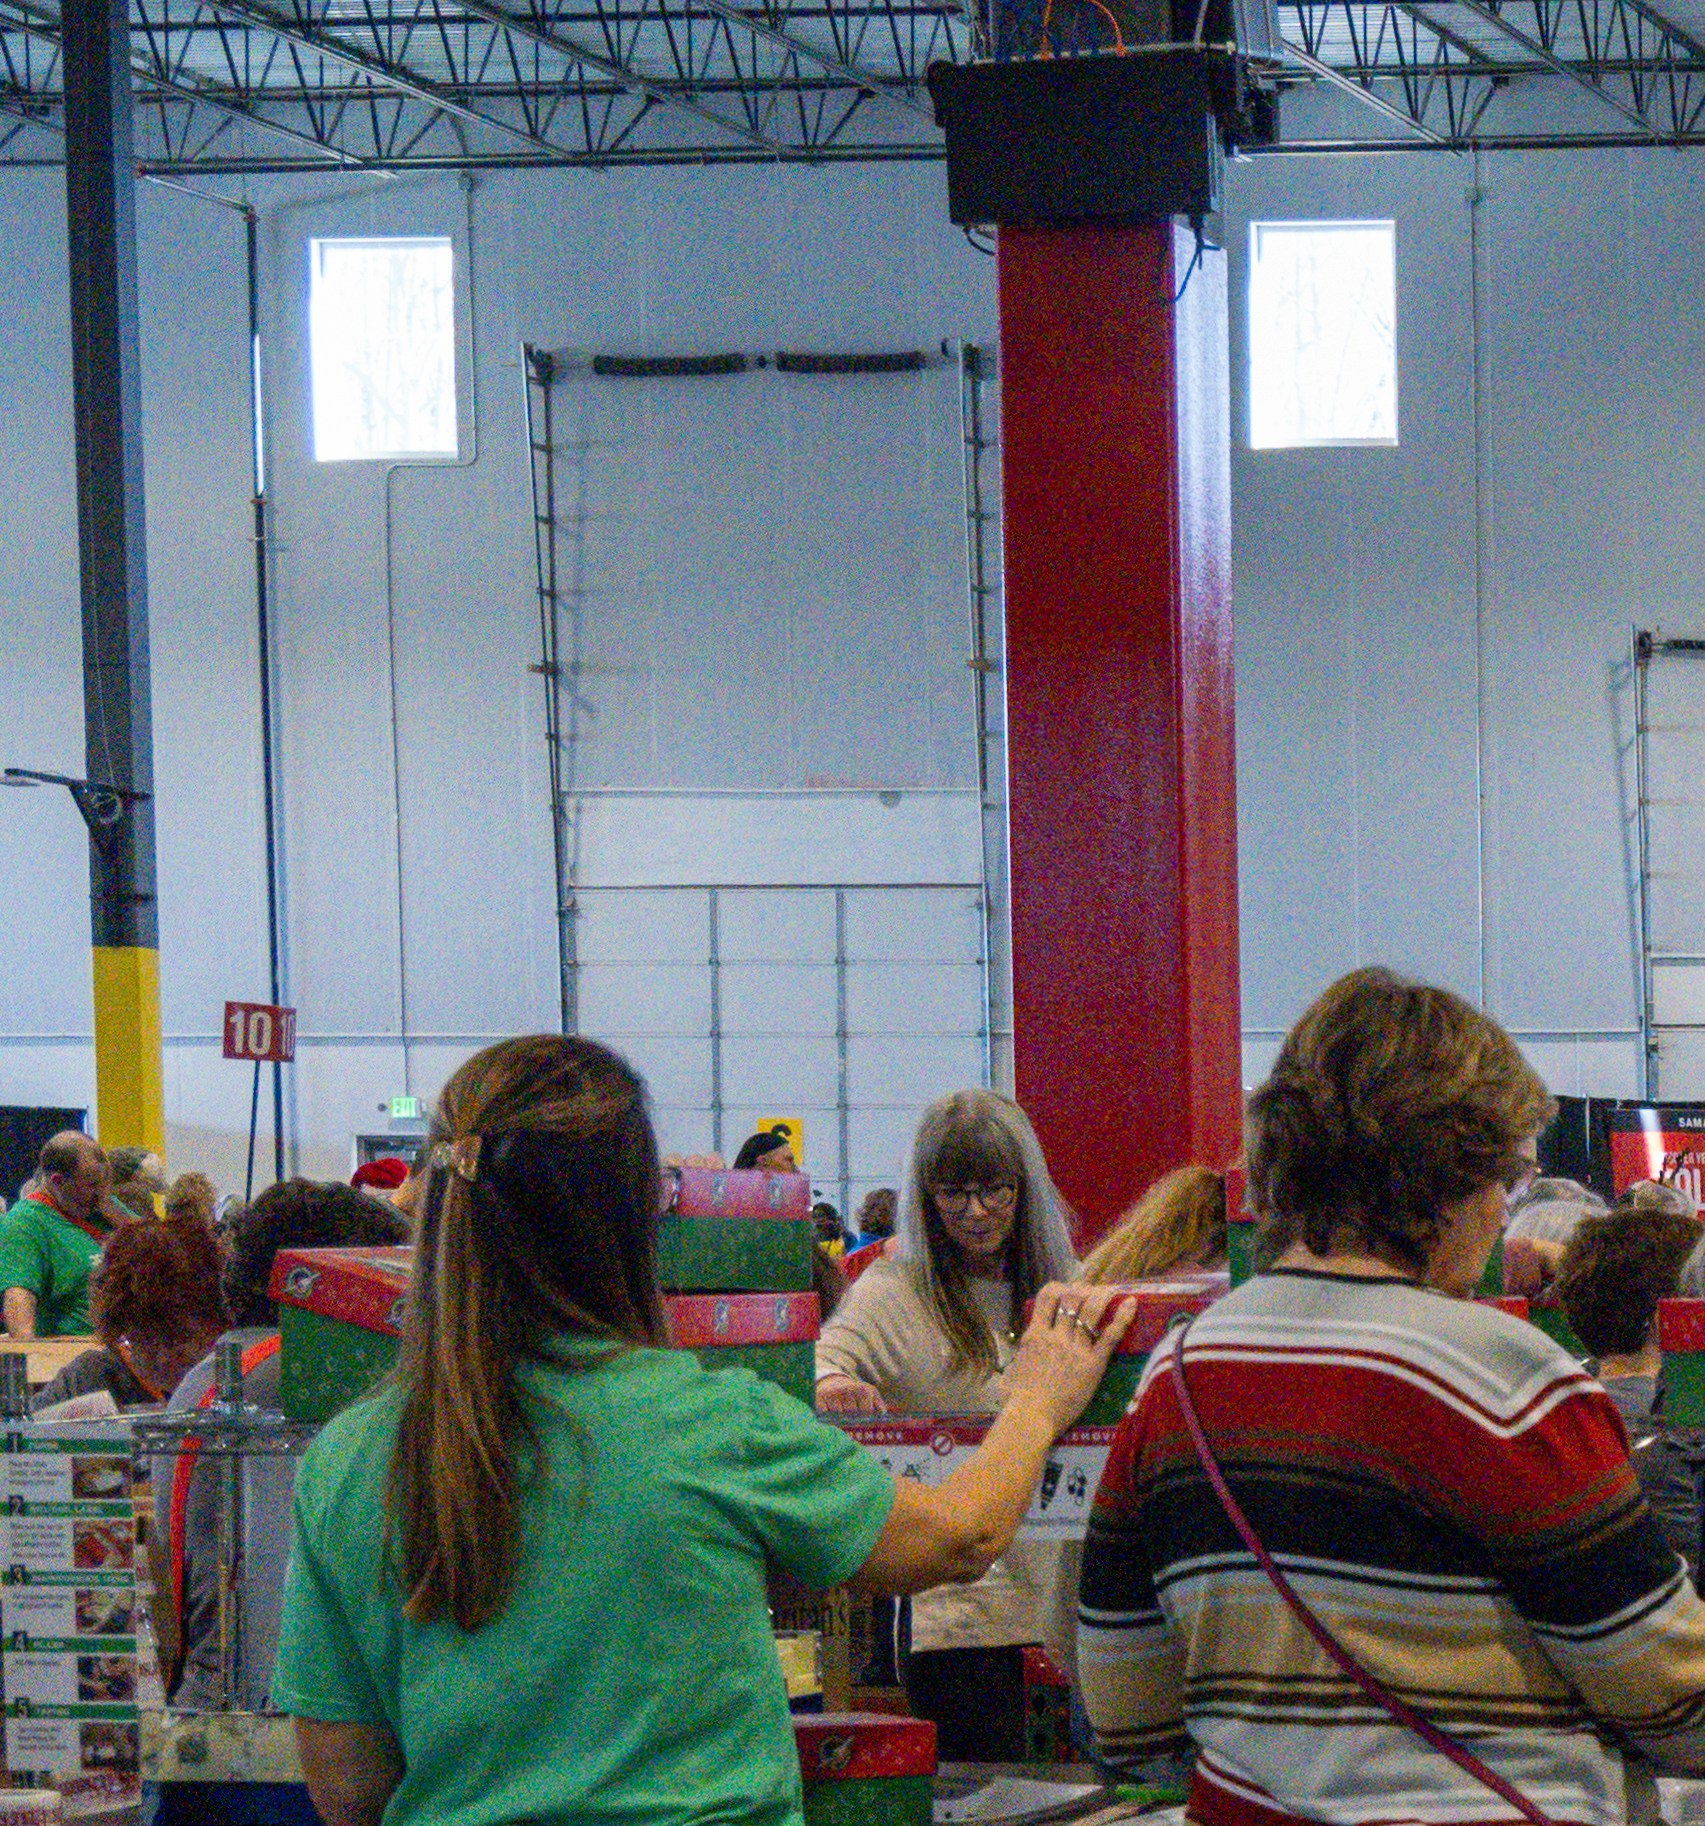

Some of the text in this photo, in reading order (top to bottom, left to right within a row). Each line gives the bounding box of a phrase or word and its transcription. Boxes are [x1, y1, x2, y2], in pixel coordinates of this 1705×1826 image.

[229, 1010, 272, 1056] 10
[397, 1098, 416, 1118] EXIT
[854, 1431, 903, 1441] EMOVE
